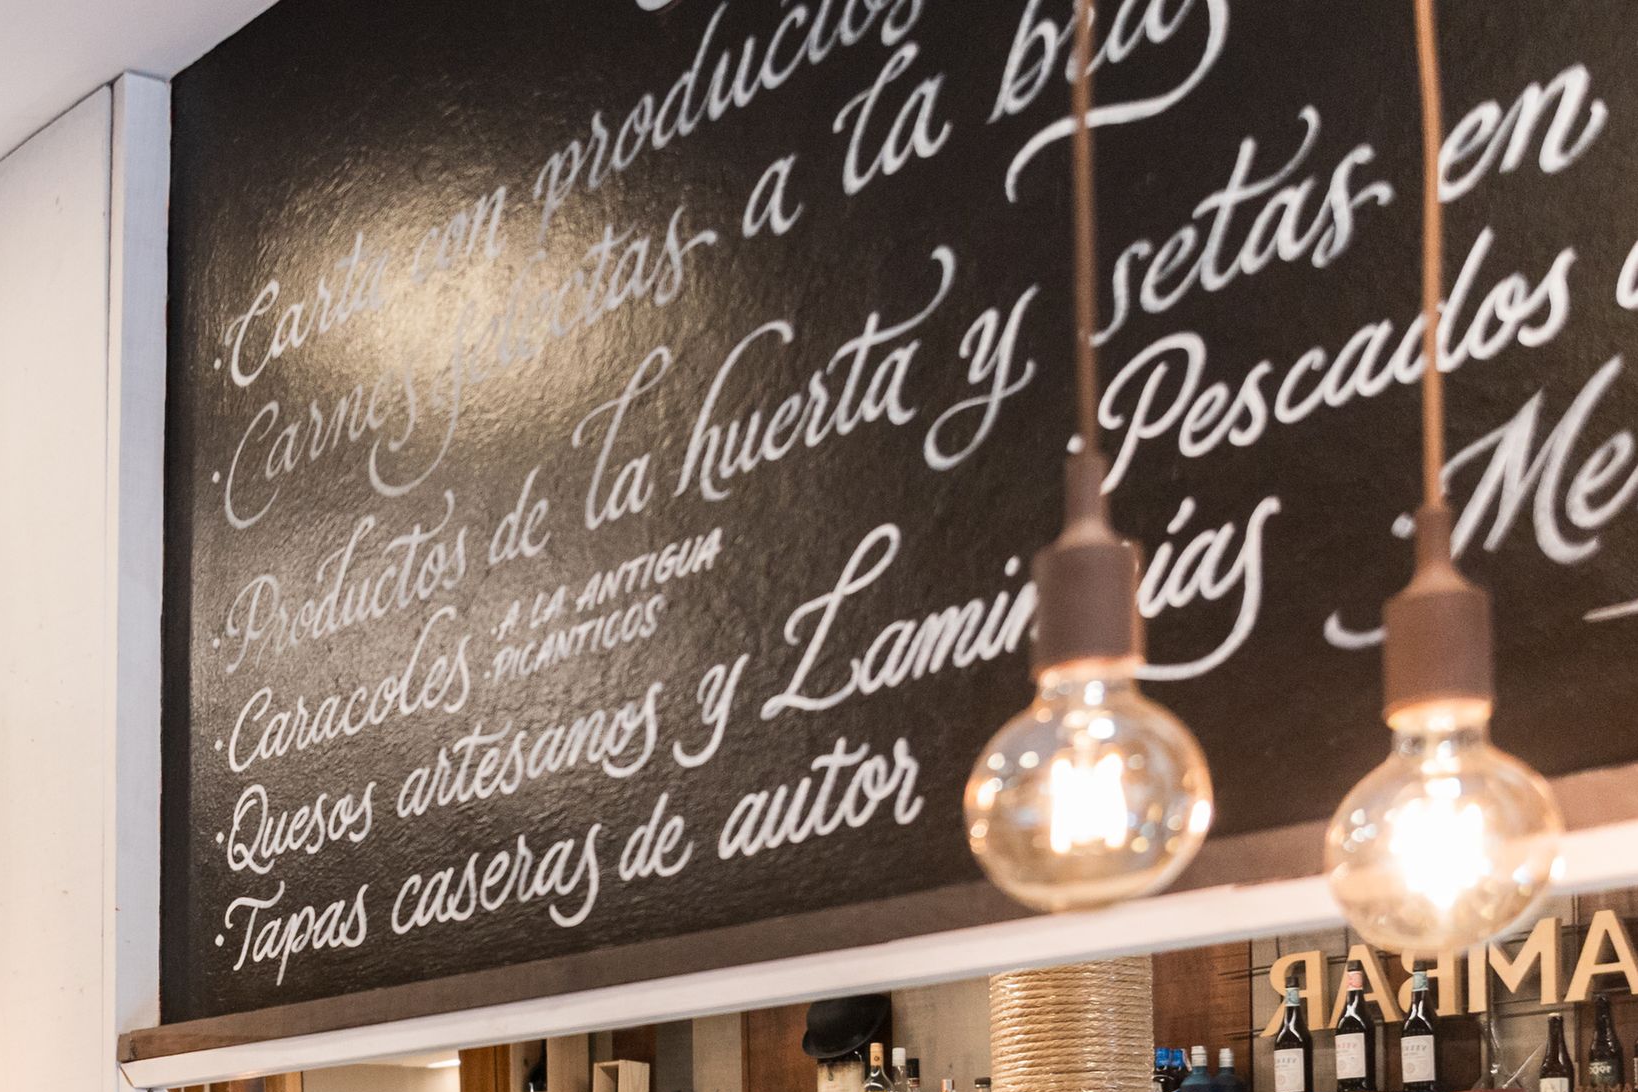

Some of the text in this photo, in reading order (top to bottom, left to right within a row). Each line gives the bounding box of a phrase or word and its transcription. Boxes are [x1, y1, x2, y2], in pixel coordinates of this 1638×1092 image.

[742, 153, 804, 237] a
[834, 41, 953, 195] la
[223, 231, 390, 387] Carta
[413, 184, 505, 284] con
[226, 492, 466, 673] Productos
[489, 468, 550, 565] de
[572, 345, 670, 529] la
[674, 246, 954, 501] huerta
[923, 283, 1040, 470] y
[1089, 104, 1394, 347] setas
[1436, 62, 1607, 202] en
[1095, 227, 1578, 497] Pescados
[226, 495, 1281, 875] Quesos artesanos y Laminías
[492, 593, 665, 684] PICANTICOS
[496, 527, 723, 641] A LA ANTIGUA
[228, 606, 470, 773] Caracoles
[224, 737, 925, 986] Tapas caseras de autor
